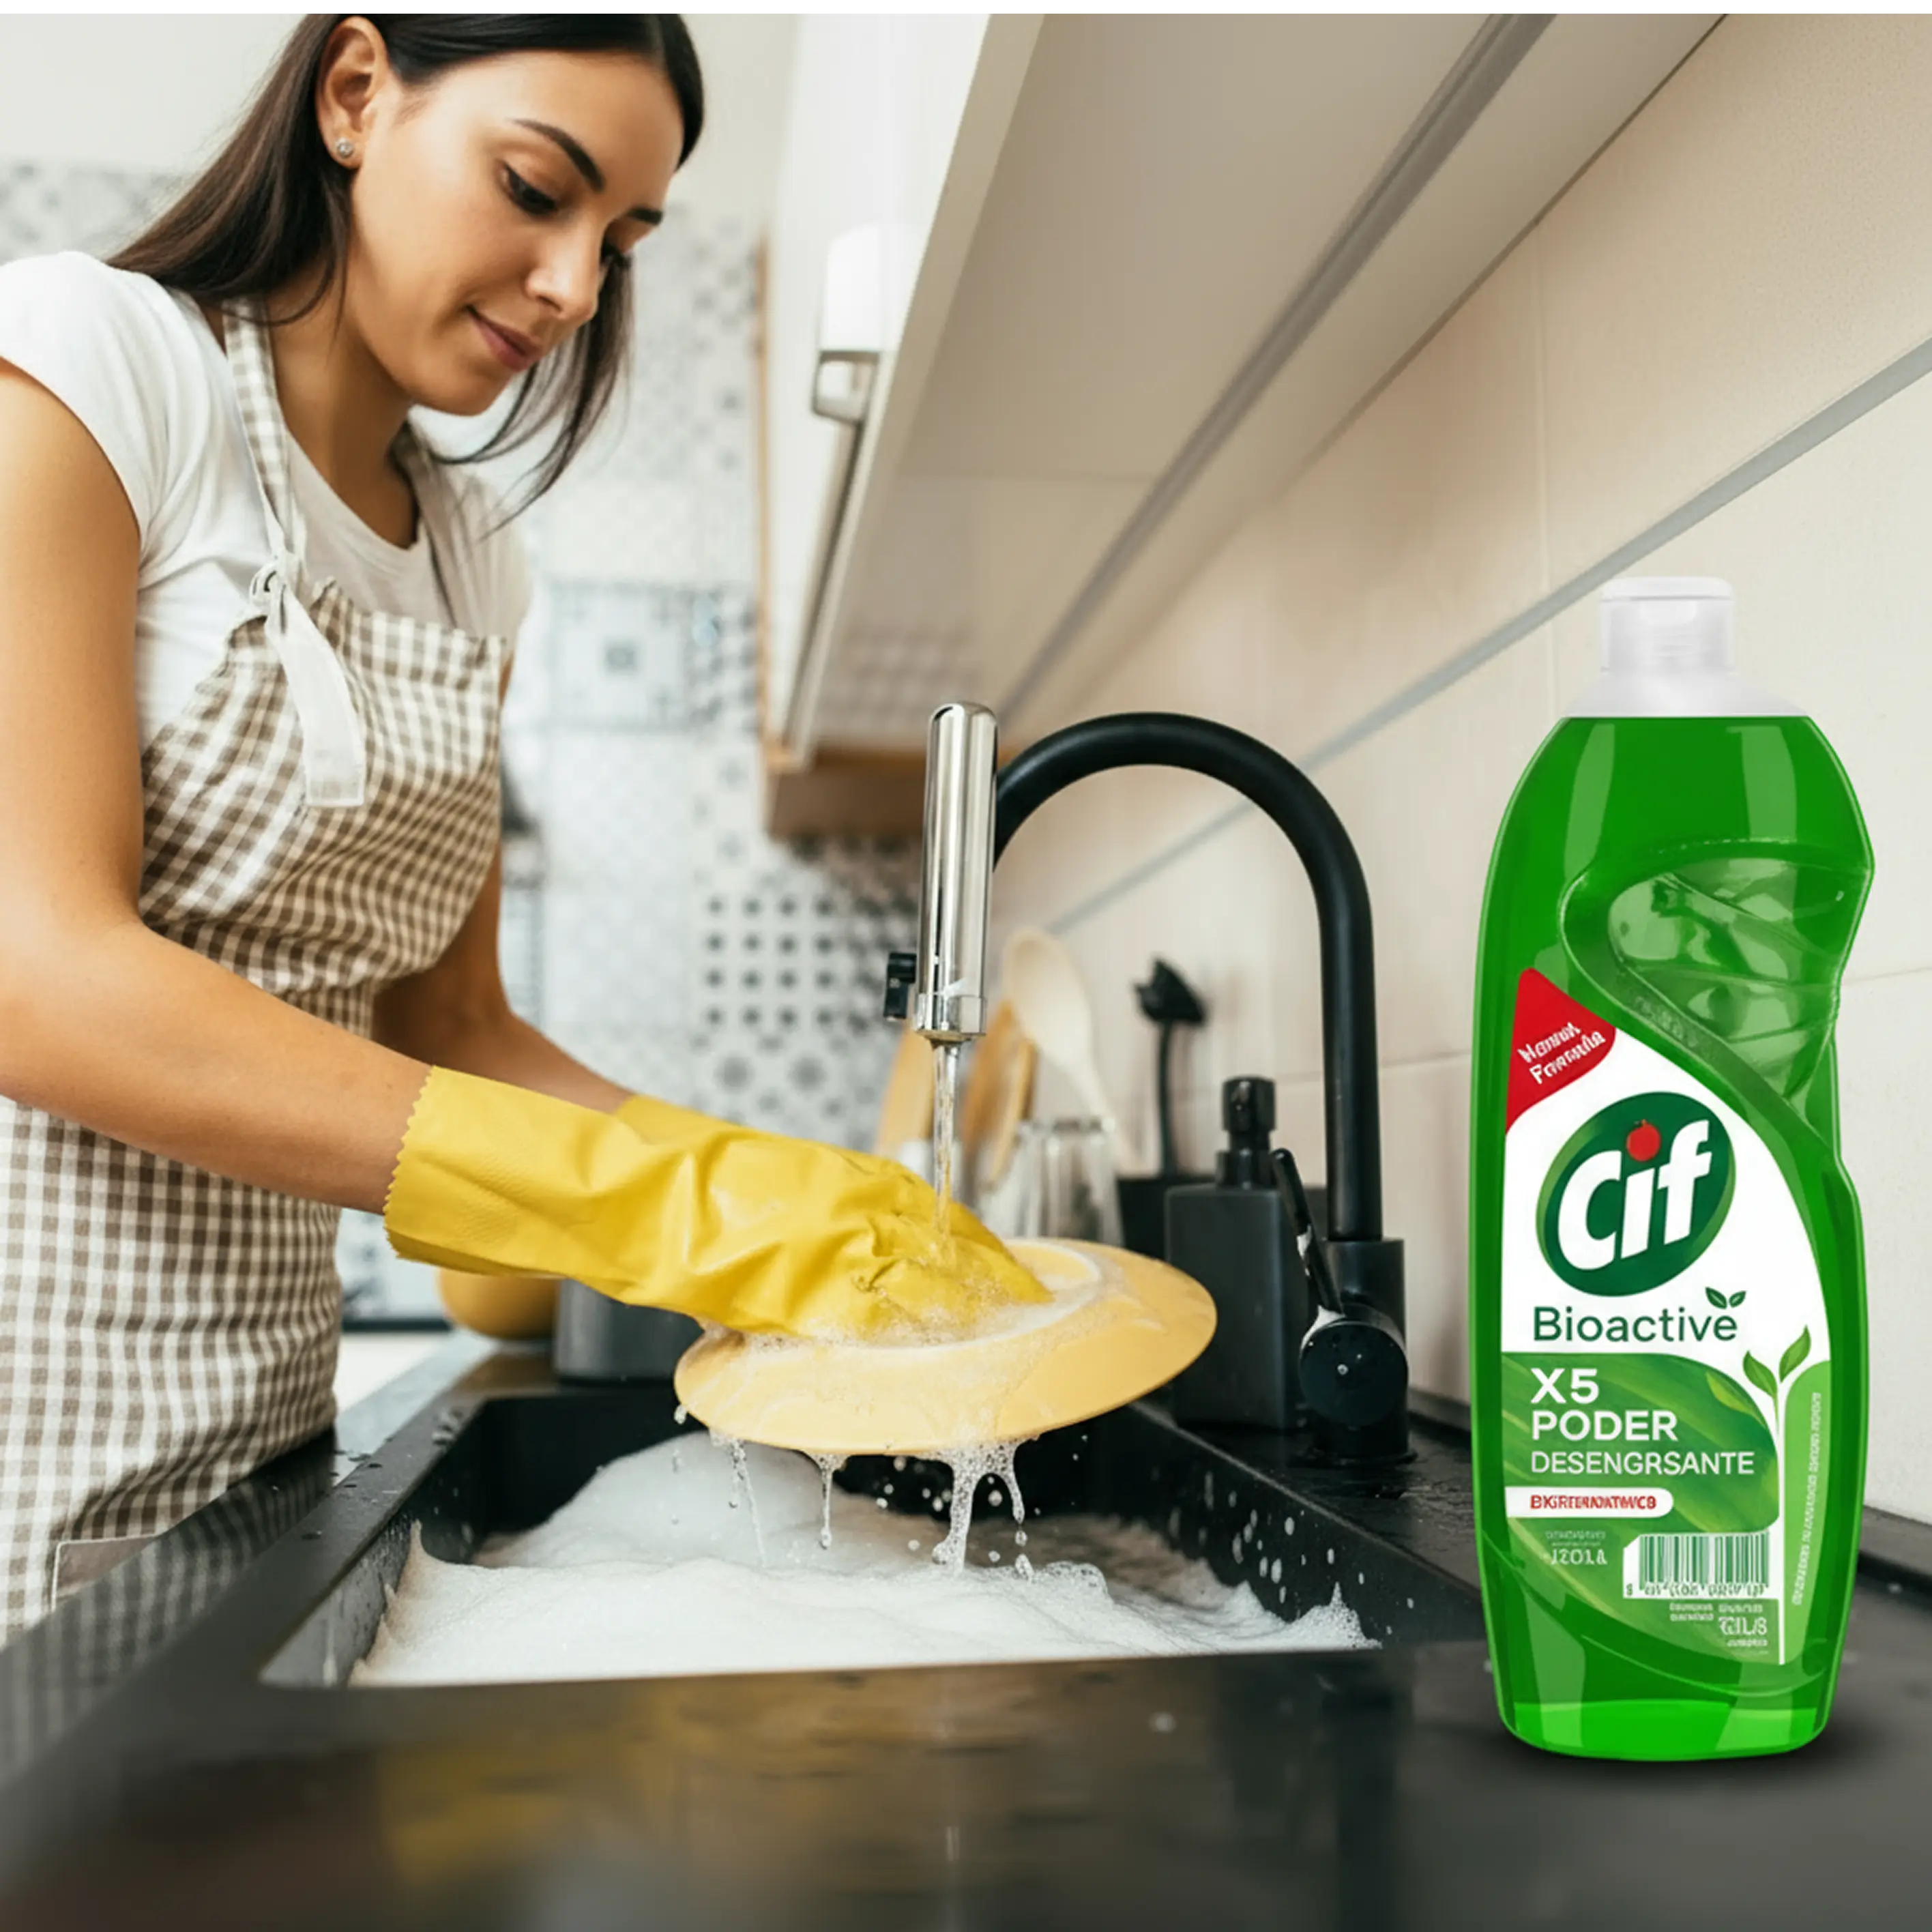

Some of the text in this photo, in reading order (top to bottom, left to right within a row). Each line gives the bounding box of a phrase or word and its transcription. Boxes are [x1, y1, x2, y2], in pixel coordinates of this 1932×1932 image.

[1557, 1119, 1712, 1270] Cif
[1533, 1306, 1738, 1342] Bioactive
[1530, 1368, 1599, 1404] X5
[1532, 1410, 1678, 1441] PODER
[1531, 1451, 1755, 1475] DESENGRSANTE
